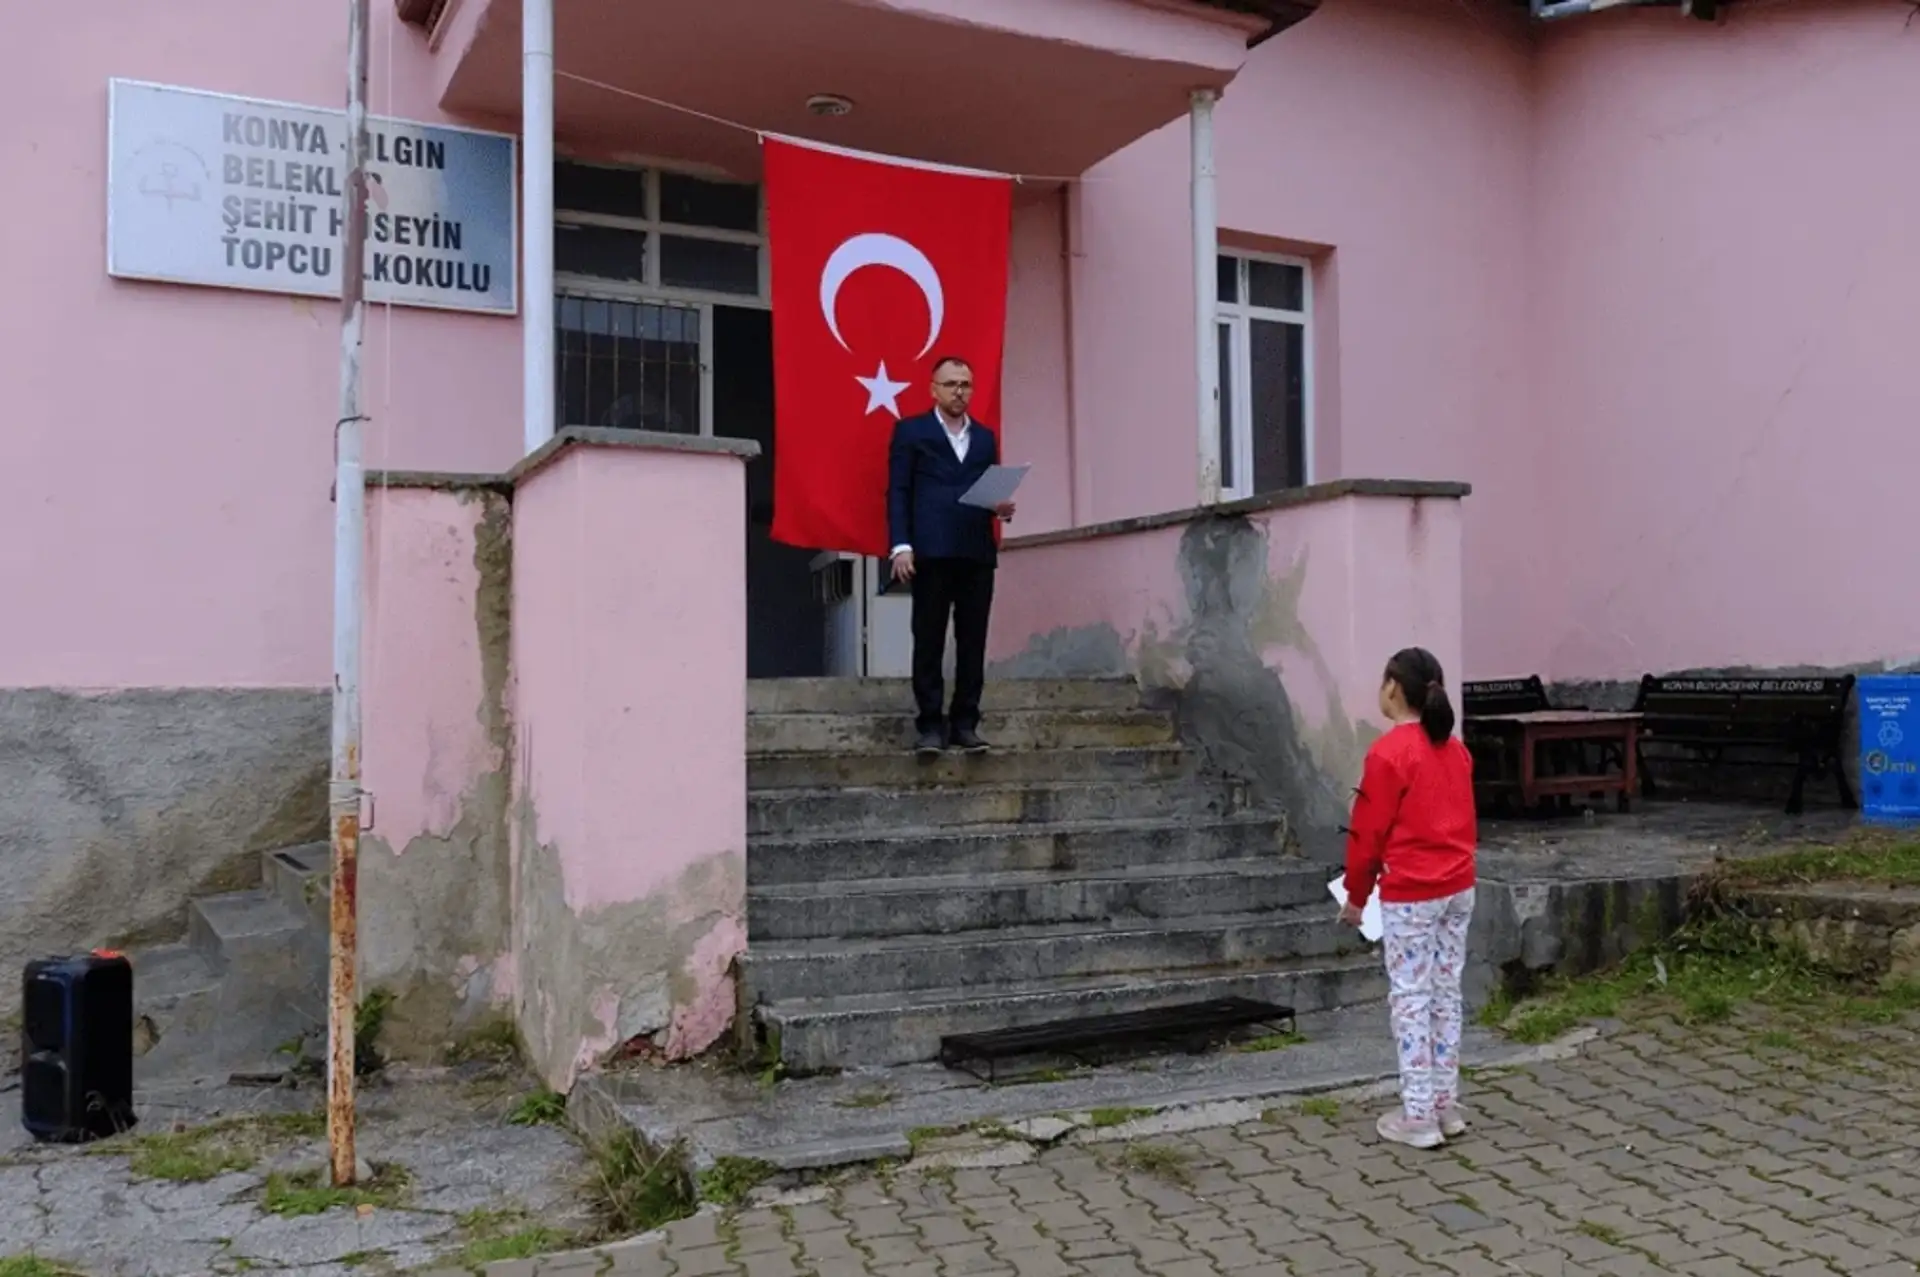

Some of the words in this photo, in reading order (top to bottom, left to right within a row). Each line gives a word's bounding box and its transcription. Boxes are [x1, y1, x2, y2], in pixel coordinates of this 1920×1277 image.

[223, 113, 328, 155] KONYA
[224, 153, 382, 196] BELEKL
[222, 194, 318, 234] ŞEHİT
[221, 236, 331, 276] TOPCU
